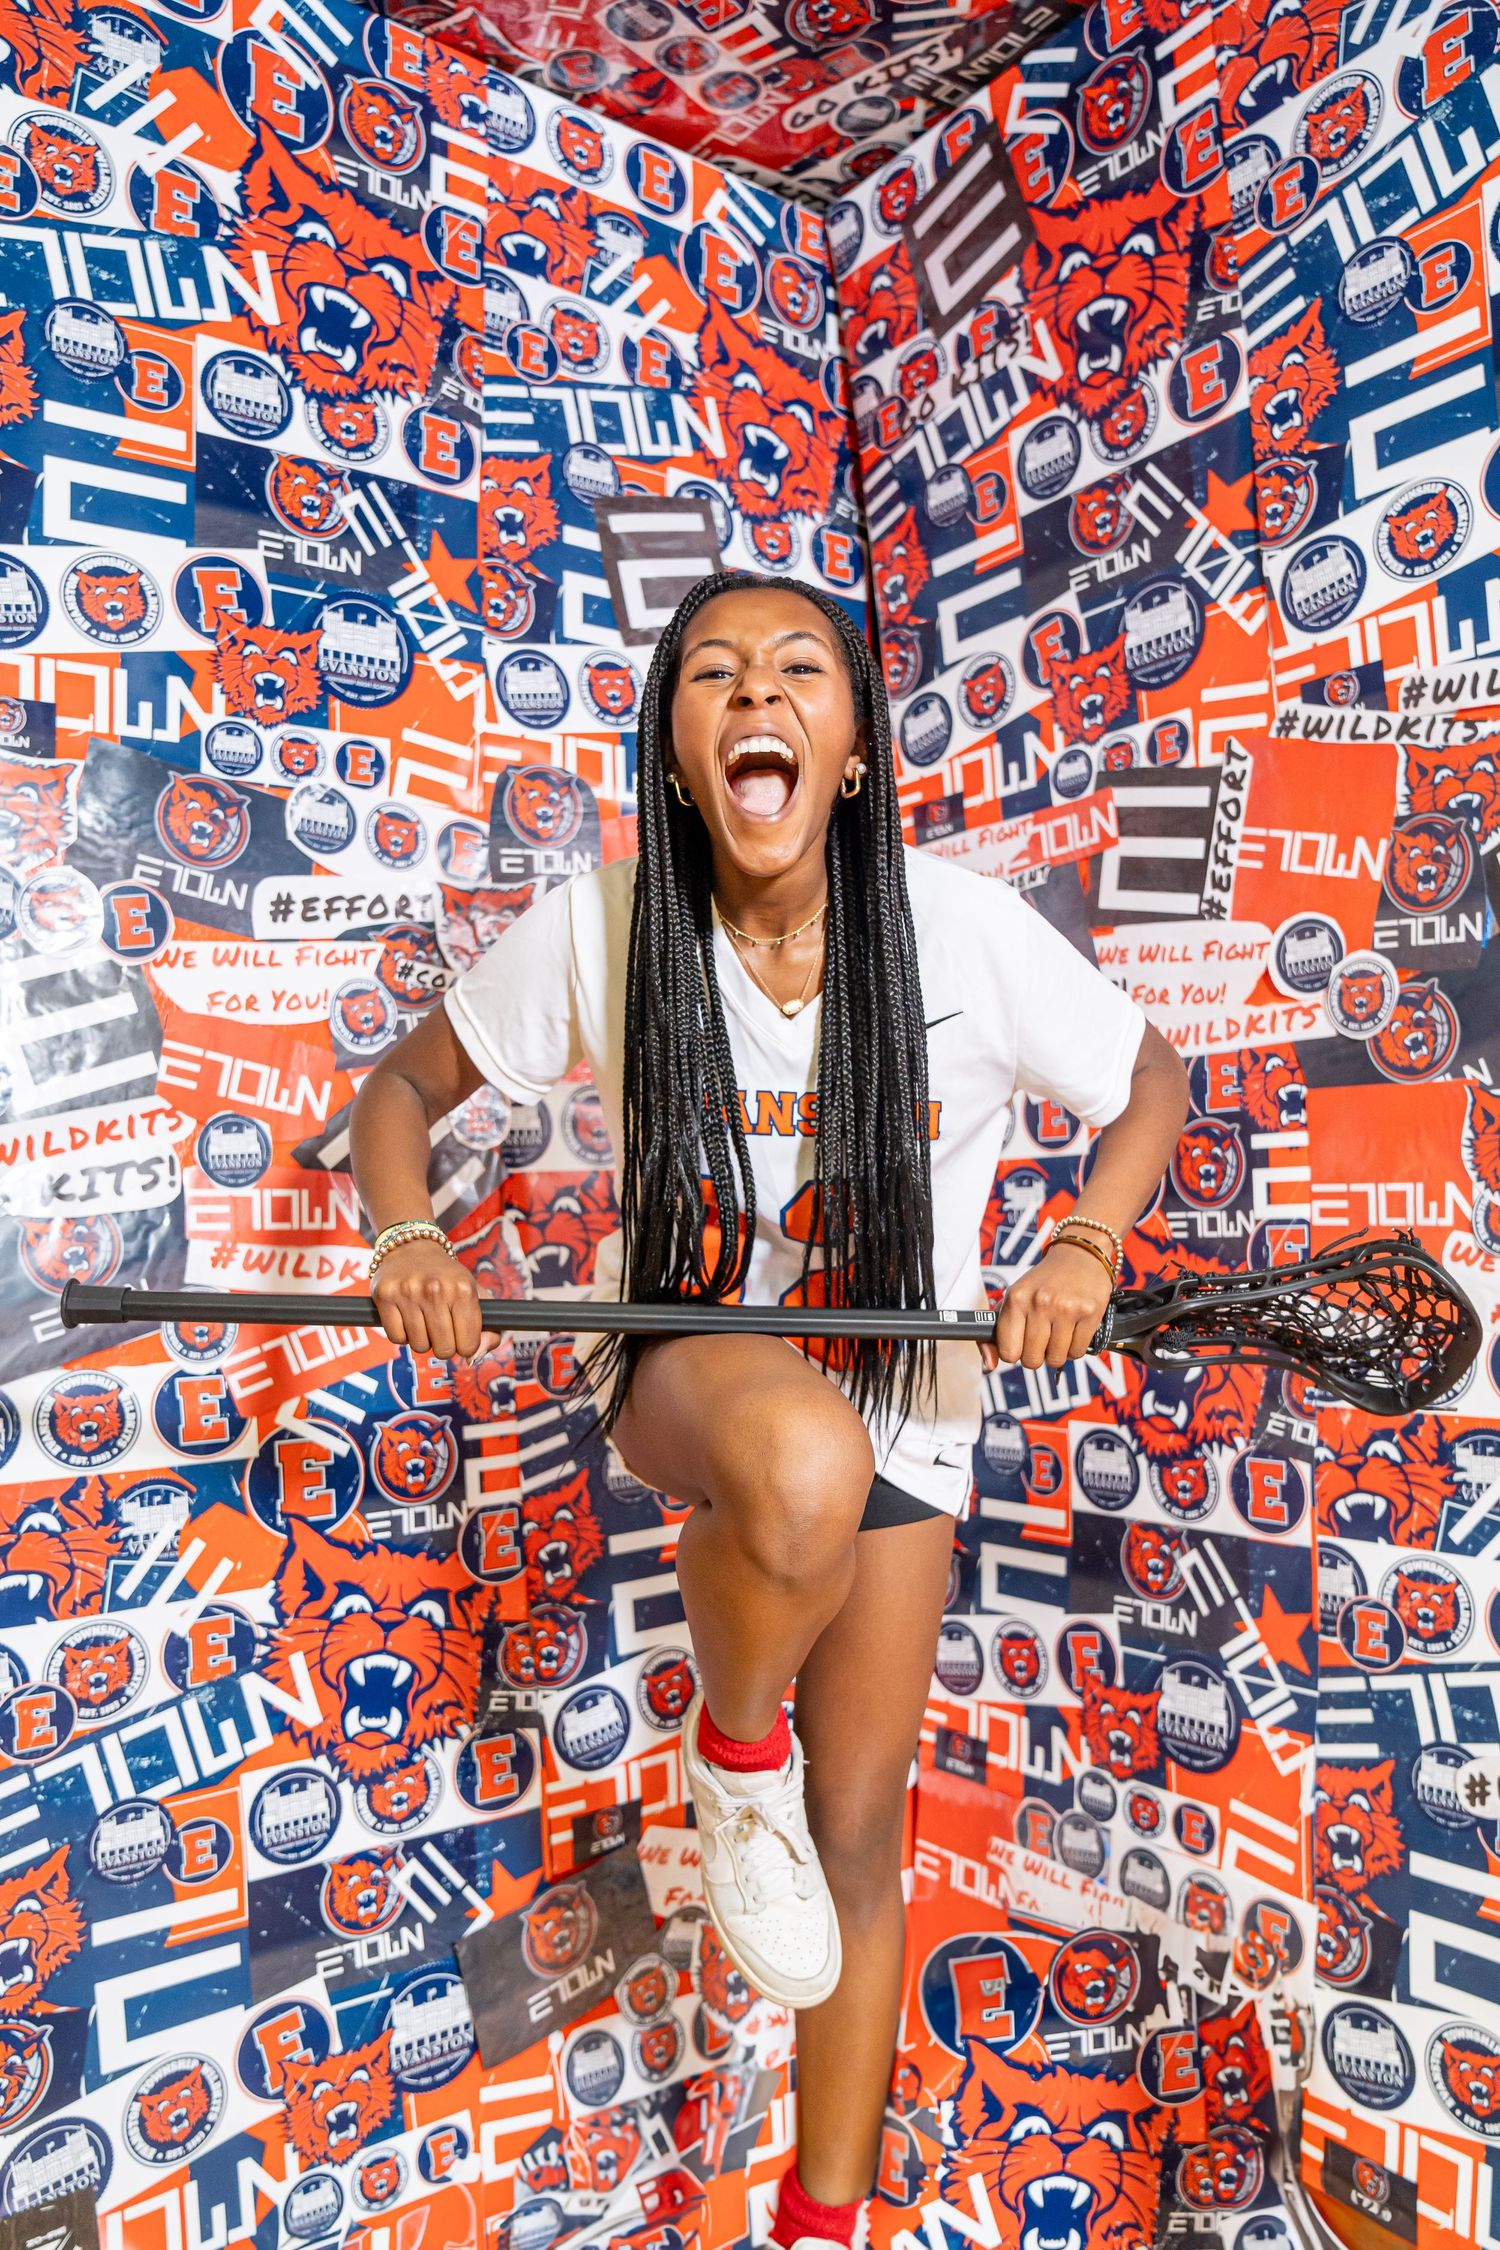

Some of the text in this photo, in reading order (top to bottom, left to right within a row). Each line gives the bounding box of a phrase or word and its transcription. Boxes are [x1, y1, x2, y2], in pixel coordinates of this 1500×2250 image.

[1421, 8, 1474, 110] E
[247, 38, 305, 143] E
[1176, 103, 1224, 188] E
[150, 168, 200, 238] E
[639, 146, 675, 210] E
[1271, 160, 1307, 227] E
[0, 223, 281, 325] TOWN
[1420, 246, 1457, 308] E
[518, 330, 548, 378] E
[635, 336, 671, 389] E
[1184, 341, 1227, 417] E
[131, 357, 169, 405] E
[420, 411, 461, 479] E
[823, 531, 854, 584] E
[319, 660, 399, 684] EVANSTON
[1155, 726, 1179, 765] E
[1277, 709, 1480, 744] #WILDKITS
[346, 745, 374, 785] E
[1237, 827, 1387, 881] ETOWN
[133, 854, 249, 909] ETOWN
[112, 894, 155, 950] E
[1374, 911, 1483, 949] ETOWN
[153, 946, 377, 970] WE WILL FIGHT
[398, 963, 446, 989] #CO
[1098, 941, 1271, 965] WE WILL FIGHT
[206, 988, 329, 1013] FOR YOU!
[1132, 983, 1171, 1005] FOR
[1181, 982, 1228, 1005] YOU!
[1157, 1003, 1321, 1048] WILDKITS
[157, 1041, 332, 1120] ETOWN
[187, 1188, 360, 1231] ETOWN
[211, 1243, 360, 1281] #WILDK
[1449, 1240, 1497, 1272] WE
[178, 1376, 230, 1445] E
[276, 1440, 336, 1520] E
[1033, 1450, 1054, 1490] E
[1247, 1457, 1289, 1525] E
[480, 1508, 521, 1574] E
[188, 1614, 235, 1688] E
[1353, 1606, 1390, 1664] E
[12, 1692, 57, 1755] E
[1160, 1719, 1227, 1749] EVANSTON
[477, 1735, 519, 1804] E
[183, 1827, 215, 1876] E
[1183, 1807, 1205, 1848] E
[1023, 1855, 1071, 1890] WILL
[1158, 2031, 1199, 2097] E
